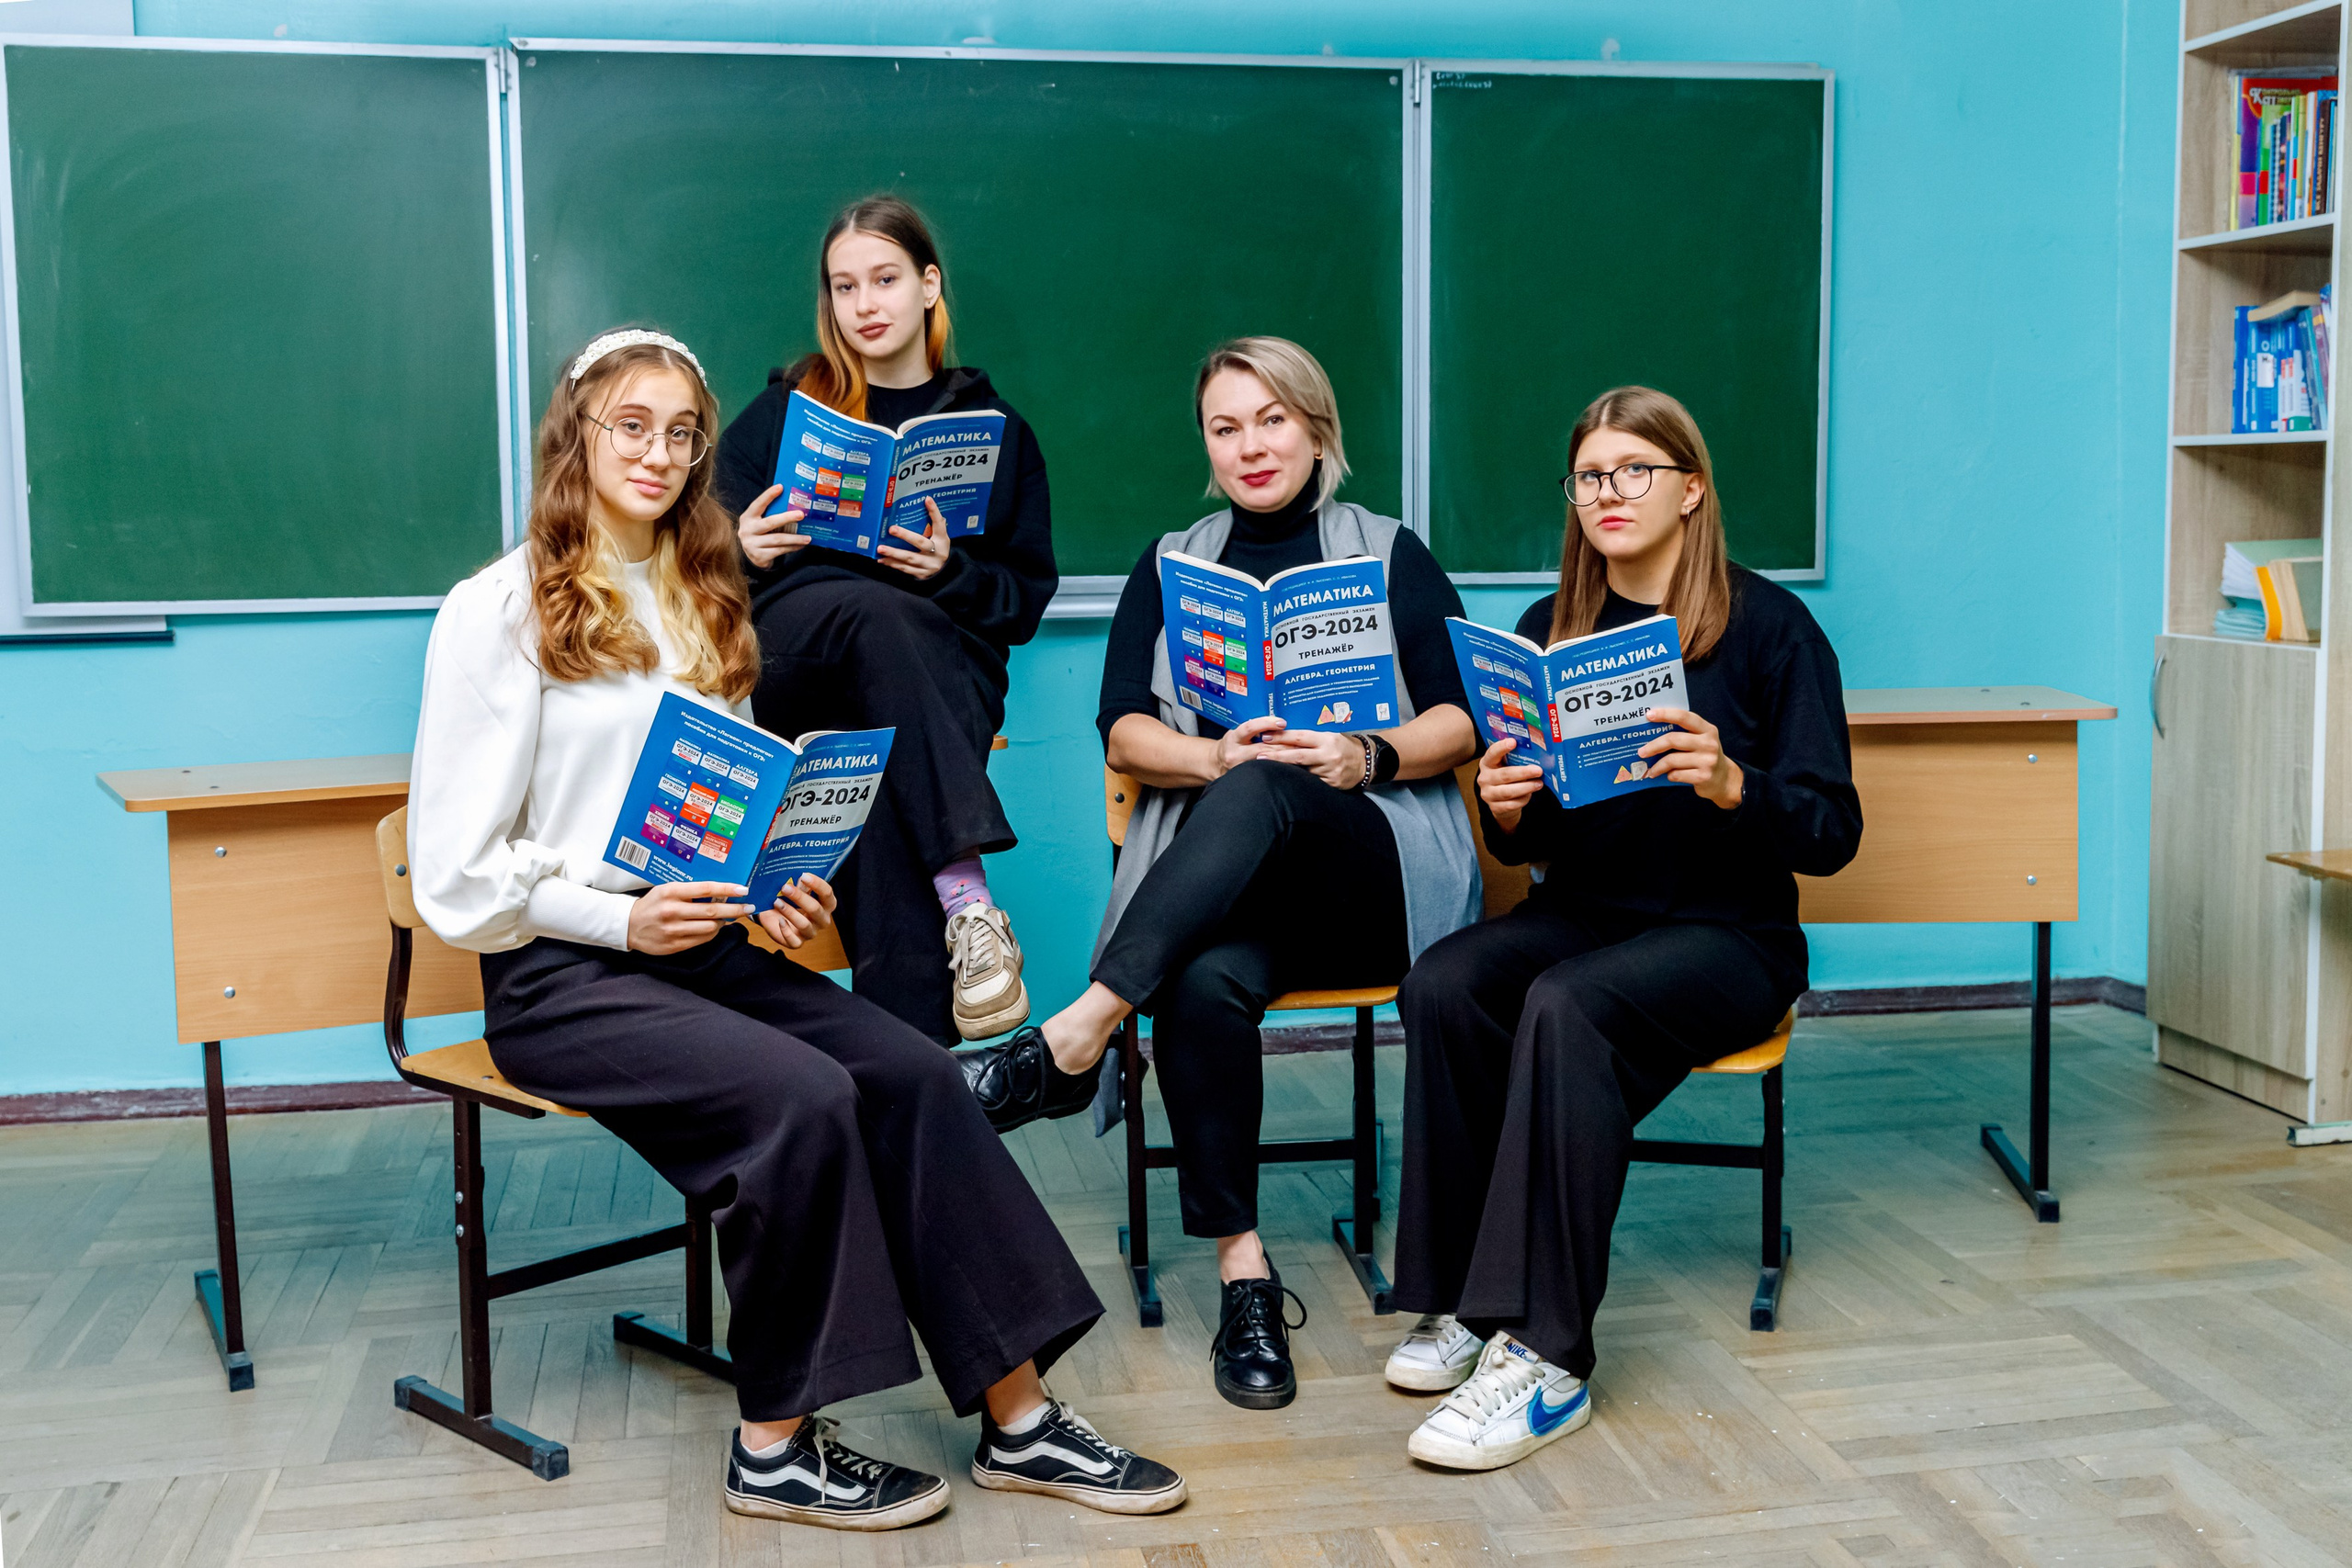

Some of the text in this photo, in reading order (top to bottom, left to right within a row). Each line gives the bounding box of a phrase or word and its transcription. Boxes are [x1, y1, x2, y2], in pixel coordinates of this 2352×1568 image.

[902, 432, 992, 457] МАТЕМАТИКА
[898, 453, 989, 480] ОГЭ-2024
[915, 473, 963, 488] ТРЕНАЖЁР
[933, 488, 977, 499] ГЕОМЕТРИЯ
[1272, 584, 1374, 618] МАТЕМАТИКА
[1274, 615, 1378, 649] ОГЭ-2024
[1275, 618, 1299, 632] ОСНОВНОЙ
[1301, 609, 1350, 622] ГОСУДАРСТВЕННЫЙ
[1264, 645, 1272, 676] ОГЭ-2024
[1298, 643, 1354, 660] ТРЕНАЖЁР
[1560, 642, 1668, 682] МАТЕМАТИКА
[1284, 663, 1375, 685] АЛГЕБРА, ГЕОМЕТРИЯ
[1544, 665, 1554, 702] МАТЕМАТИКА
[1564, 665, 1670, 695] ОСНОВНОЙ ГОСУДАРСТВЕННЫЙ ЭКЗАМЕН
[1564, 672, 1674, 714] ОГЭ-2024
[680, 711, 775, 759] Издательство «Легион» предлагает
[1549, 708, 1560, 739] ОГЭ-2024
[684, 721, 707, 735] пособия
[717, 737, 748, 754] подготовки
[1579, 735, 1622, 750] АЛГЕБРА,
[1623, 724, 1674, 739] ГЕОМЕТРИЯ
[704, 757, 728, 771] ОГЭ-2024
[735, 763, 758, 777] АЛГЕБРА
[793, 753, 878, 779] МАТЕМАТИКА
[807, 779, 852, 787] ГОСУДАРСТВЕННЫЙ
[780, 784, 871, 815] ОГЭ-2024
[789, 814, 842, 828] ТРЕНАЖЁР
[768, 835, 851, 854] АЛГЕБРА, ГЕОМЕТРИЯ
[653, 854, 694, 882] www.legionr.ru
[1507, 1342, 1529, 1359] NIKE
